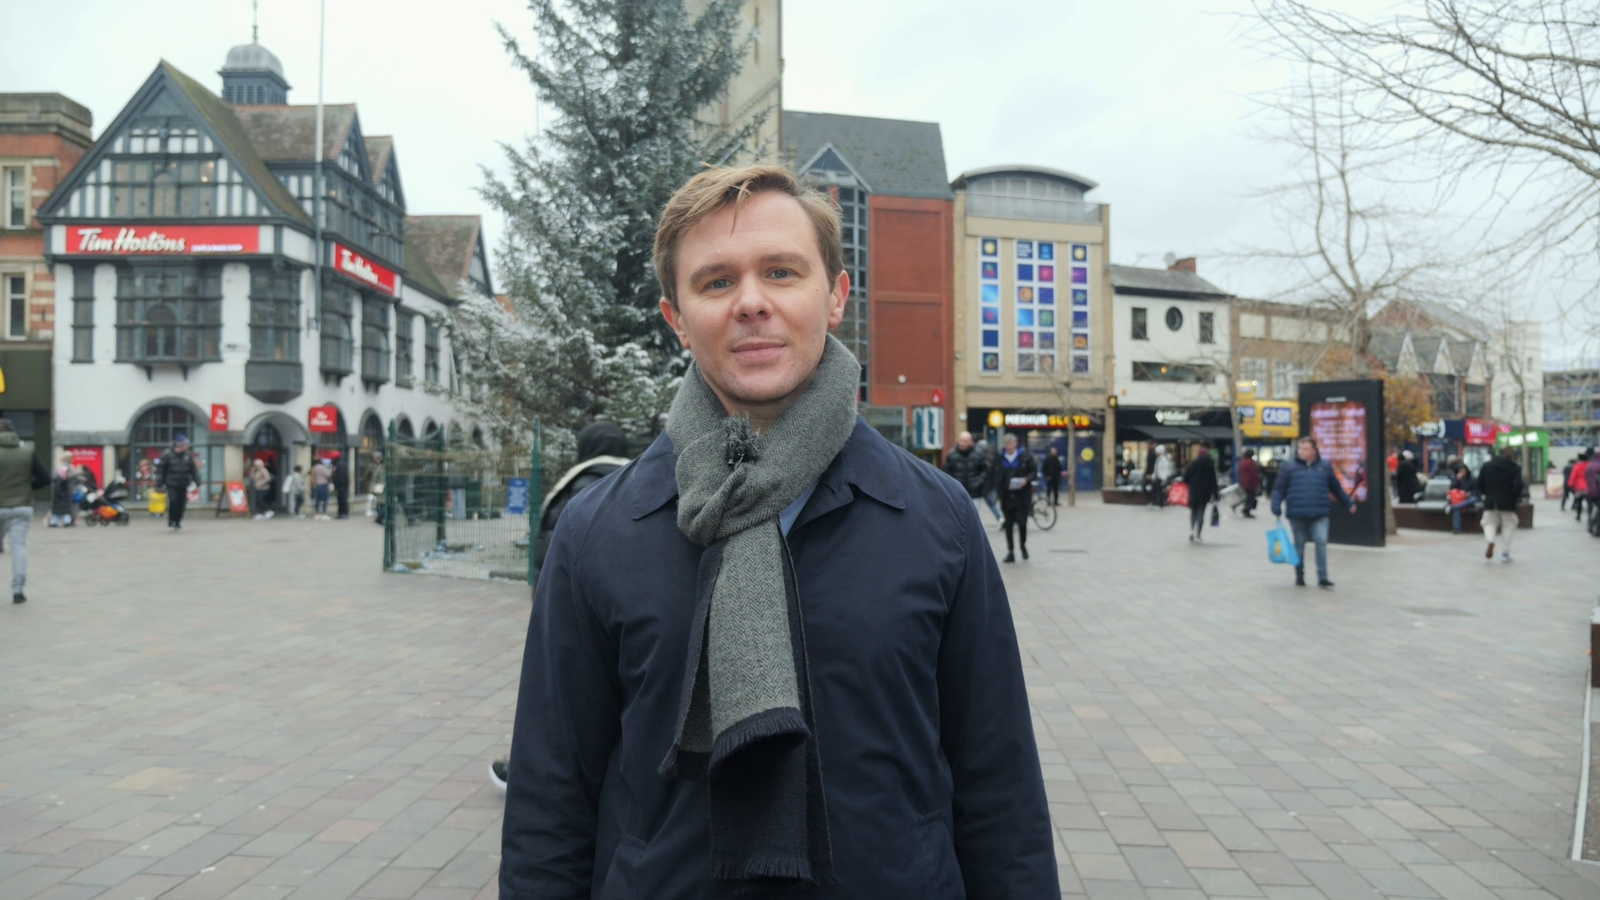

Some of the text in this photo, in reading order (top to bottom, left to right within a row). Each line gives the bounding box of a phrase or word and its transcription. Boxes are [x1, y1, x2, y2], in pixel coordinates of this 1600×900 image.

[78, 227, 185, 252] Tim Hortons
[340, 248, 355, 273] Tim
[354, 254, 379, 285] Hortons
[1005, 414, 1048, 426] MERKUR
[1263, 408, 1290, 424] CASH
